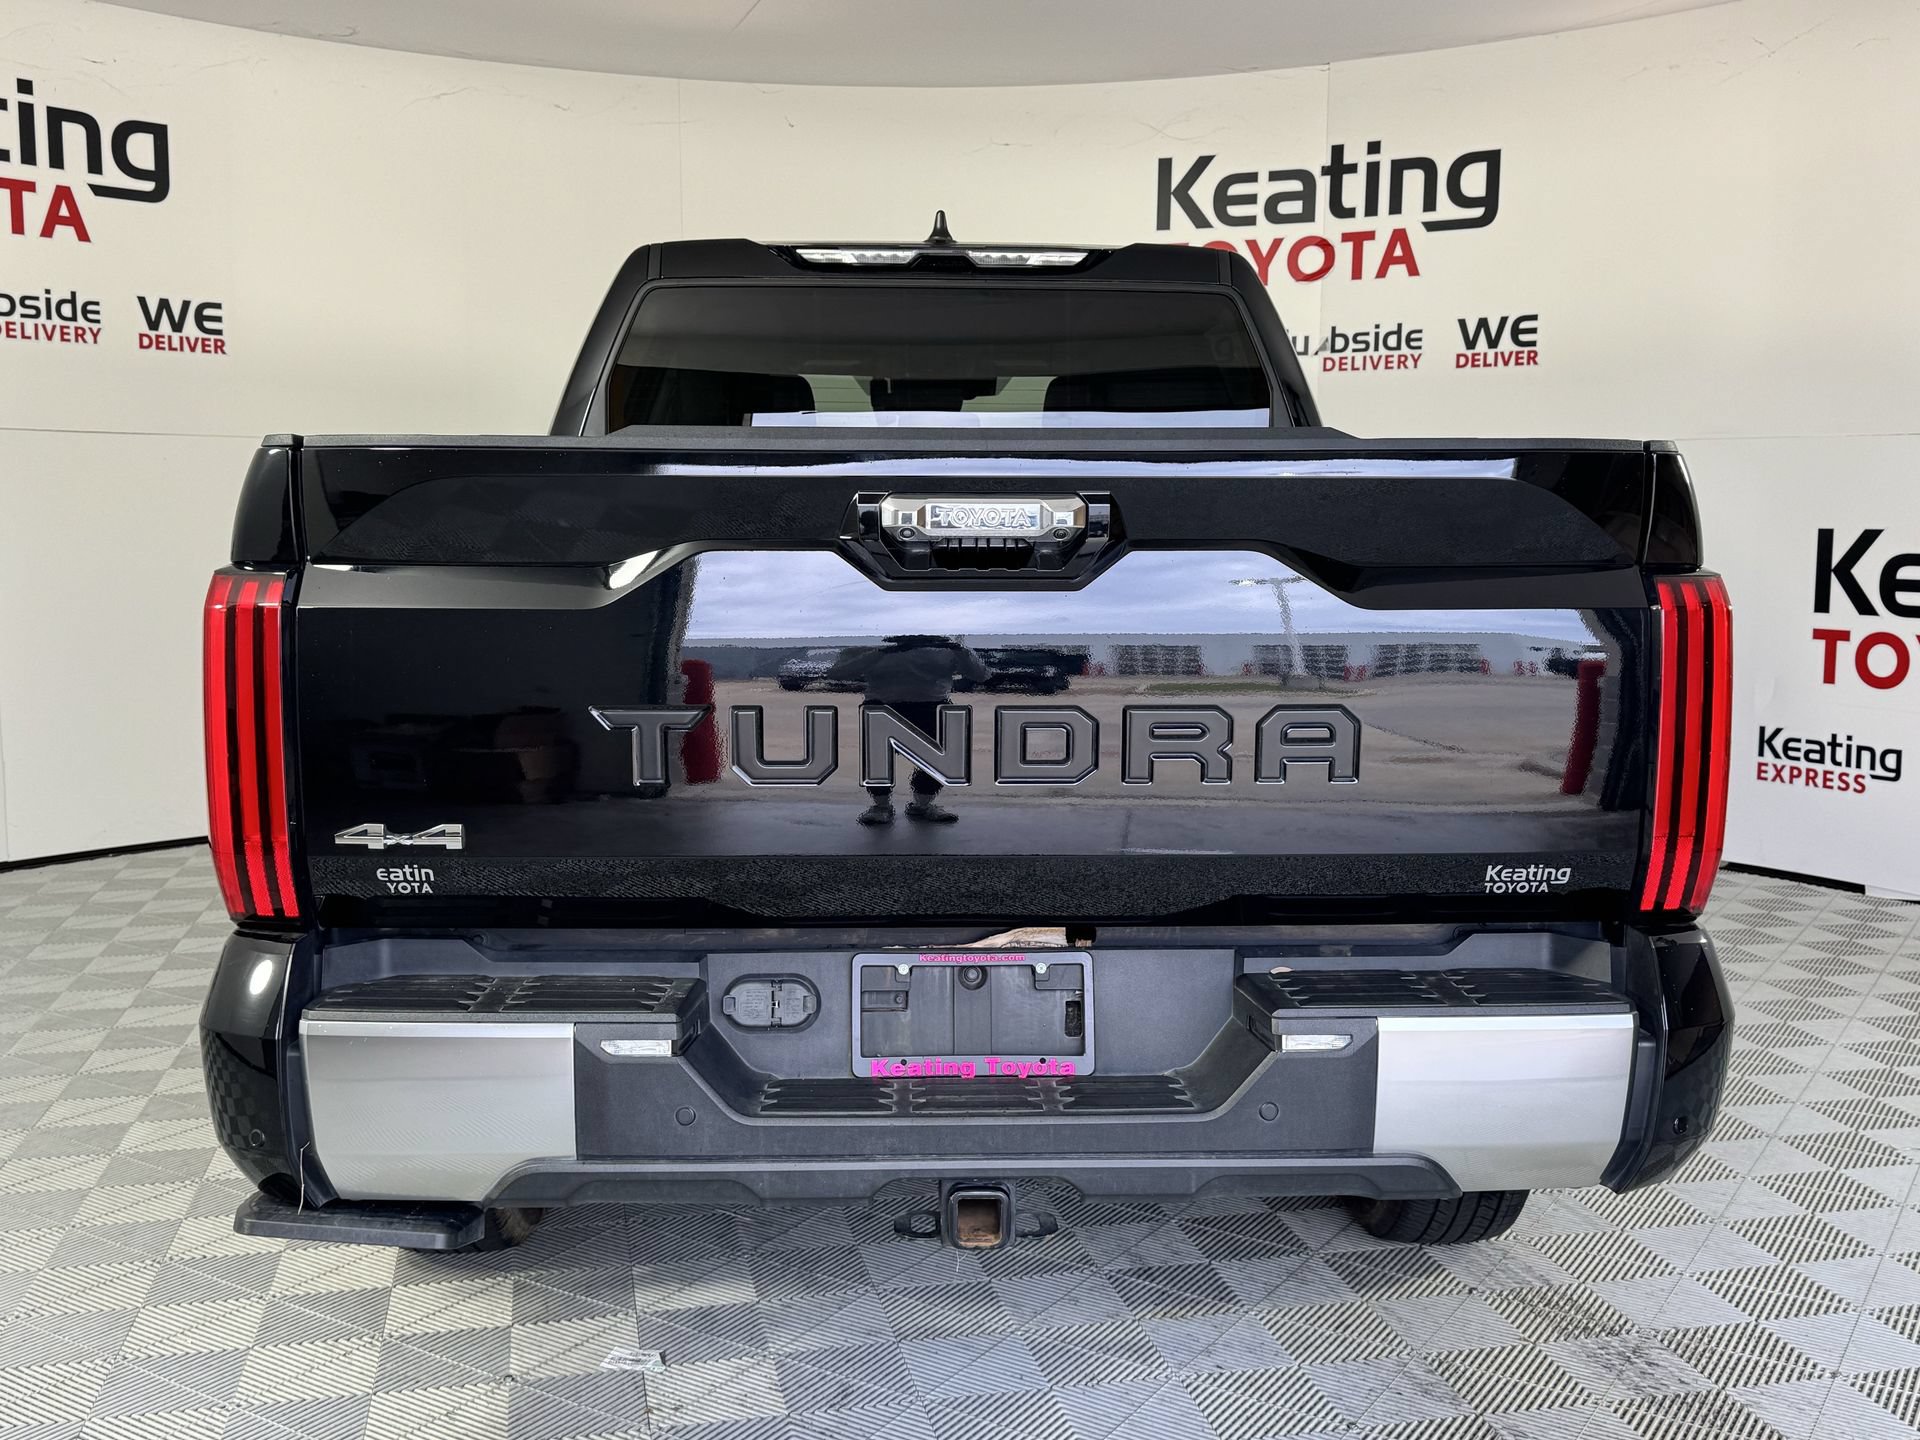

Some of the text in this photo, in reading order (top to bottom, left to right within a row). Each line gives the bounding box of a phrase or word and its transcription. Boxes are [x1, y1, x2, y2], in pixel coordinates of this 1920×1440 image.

[1156, 140, 1501, 232] Keating
[137, 296, 223, 336] WE
[0, 320, 102, 345] ELIVERY
[1458, 314, 1538, 350] WE
[139, 333, 227, 355] DELIVER
[1323, 353, 1423, 372] DELIVERY
[1456, 350, 1539, 369] DELIVER
[937, 506, 1033, 527] TOYOTA
[588, 703, 1362, 788] TUNDRA
[1757, 725, 1903, 782] Keating
[1756, 761, 1867, 794] EXPRESS
[1485, 864, 1572, 885] Keating
[386, 882, 433, 894] YOTA
[1484, 881, 1549, 894] TOYOTA
[918, 953, 1026, 963] Keatingtoyota.com
[871, 1057, 1076, 1079] Keating Toyota
